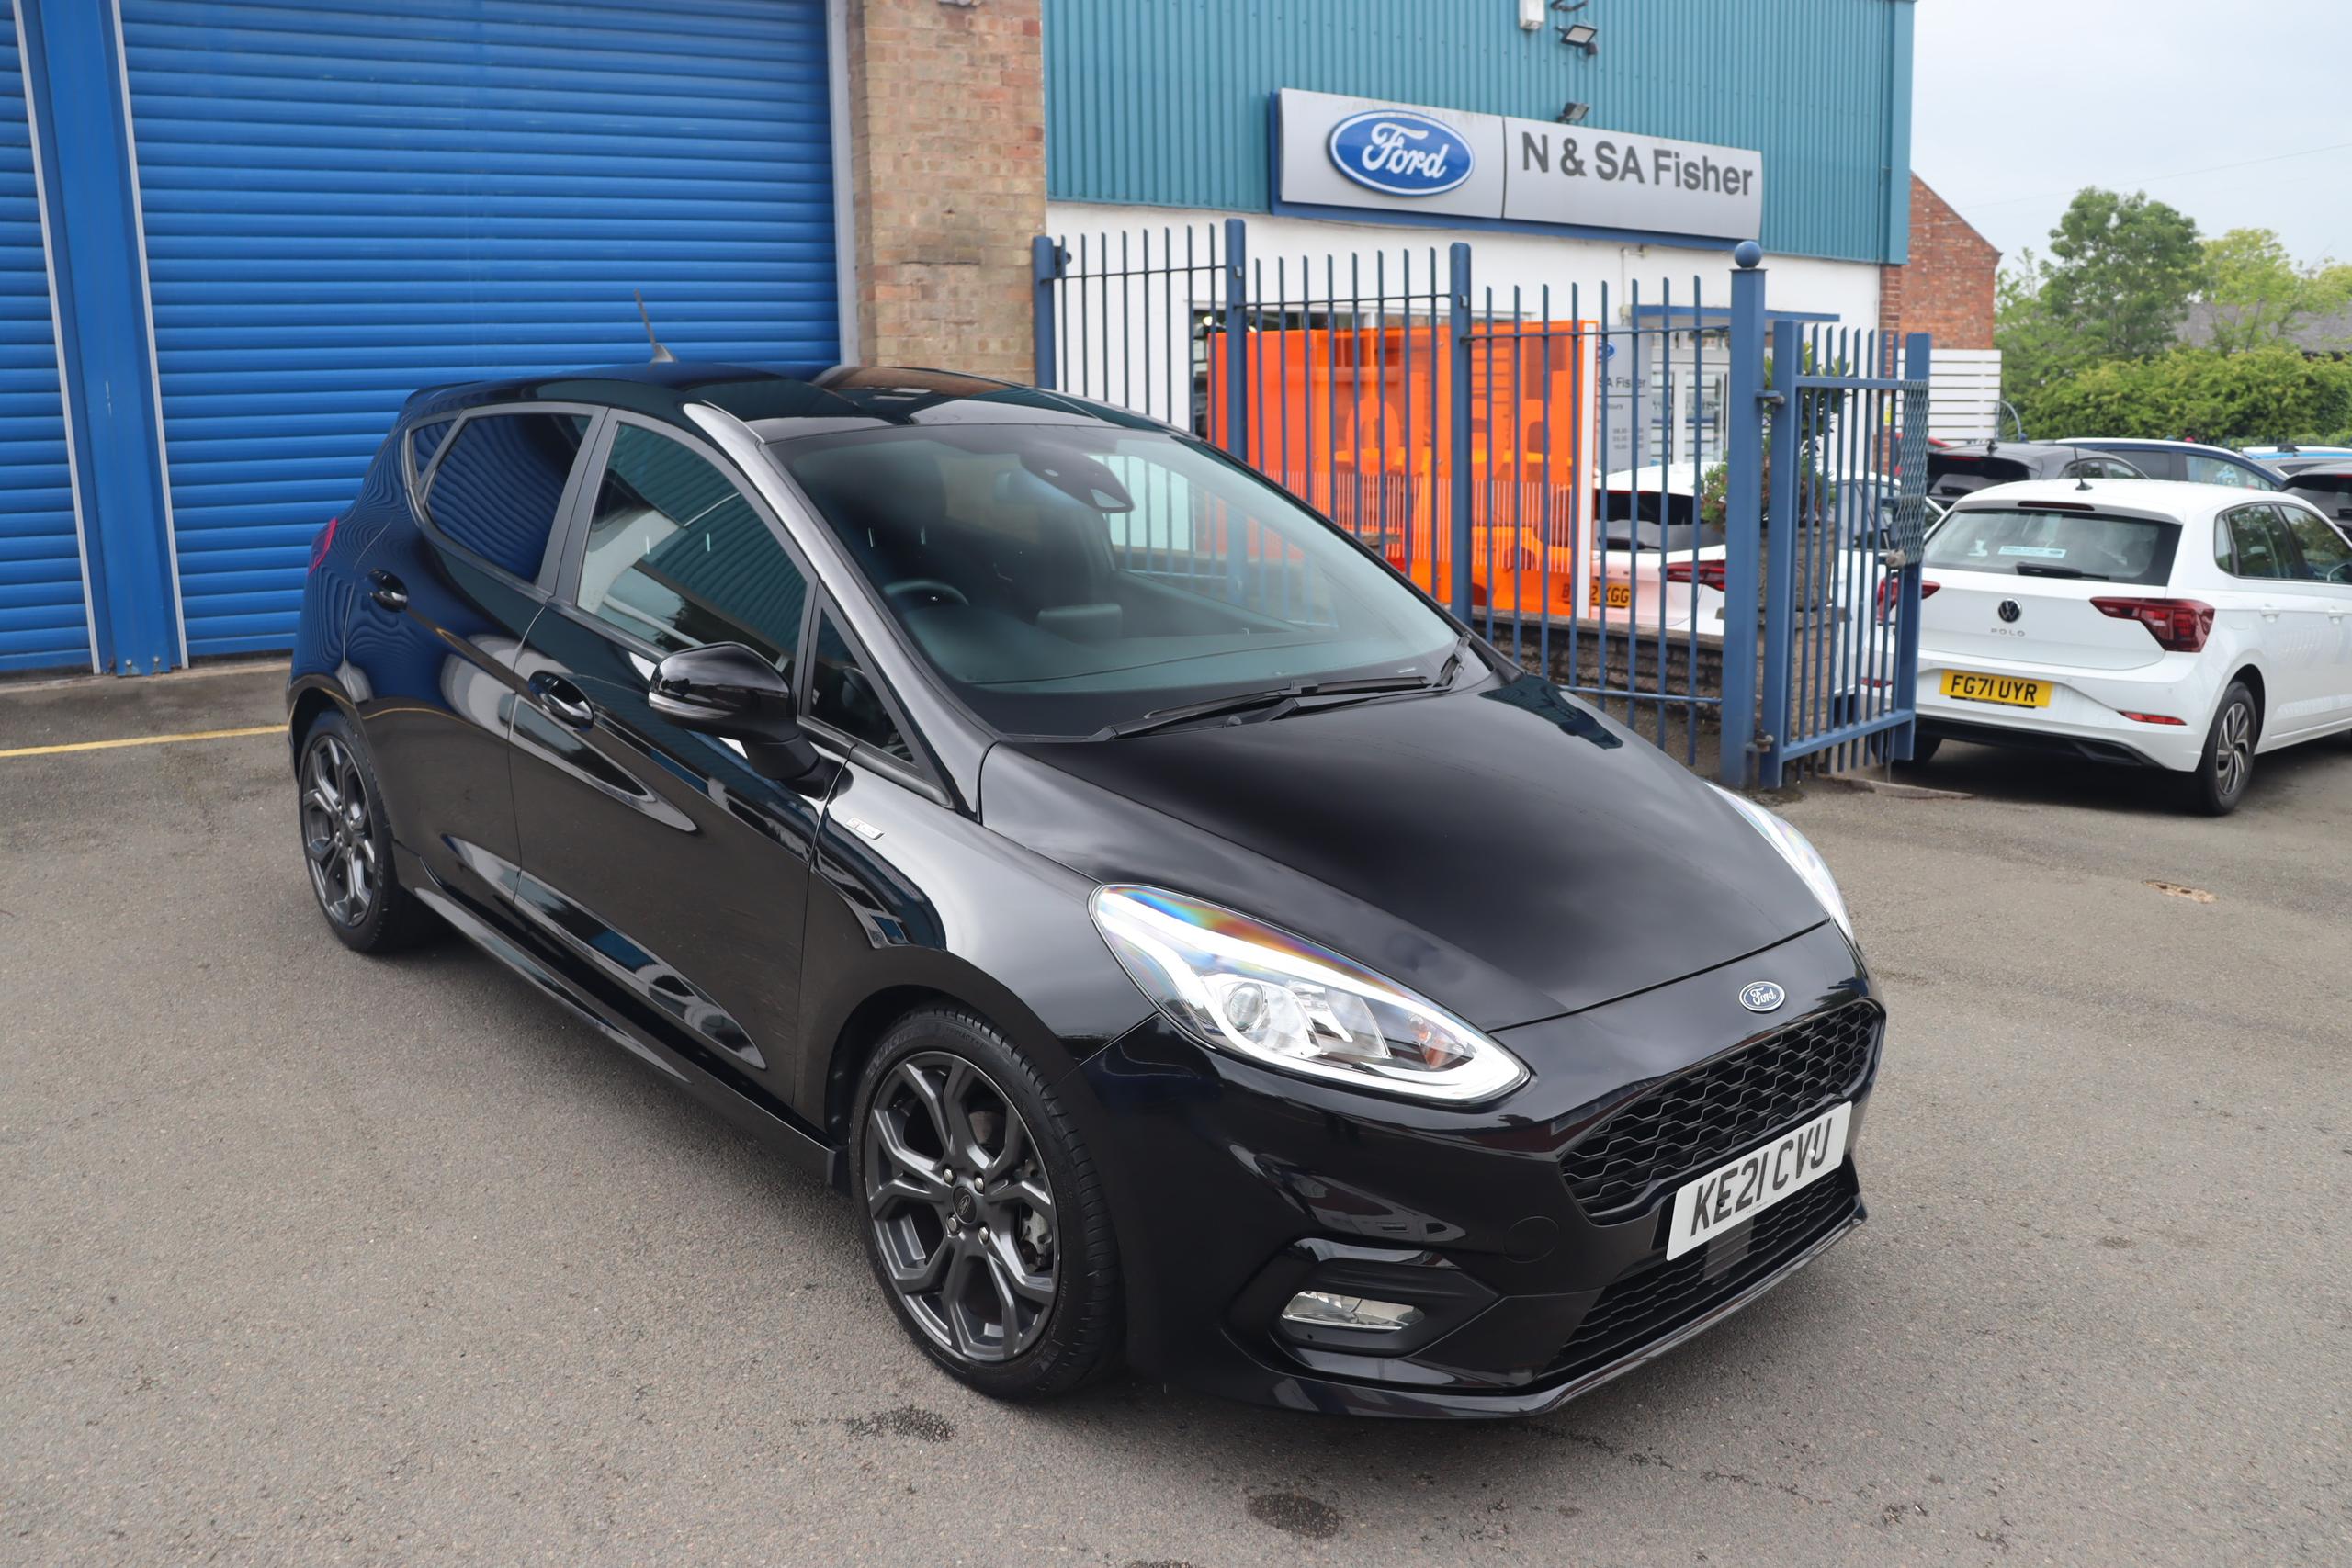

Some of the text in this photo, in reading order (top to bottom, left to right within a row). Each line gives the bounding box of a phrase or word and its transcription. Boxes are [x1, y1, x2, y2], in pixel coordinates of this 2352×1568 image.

[1362, 122, 1450, 178] Ford
[1521, 131, 1753, 196] N & SA Fisher
[1616, 377, 1645, 389] Fiser
[1990, 627, 2026, 637] POLO
[1951, 674, 2038, 703] FG71 UYR
[1749, 987, 1777, 1006] Ford
[1690, 1117, 1833, 1237] KE21 CVU
